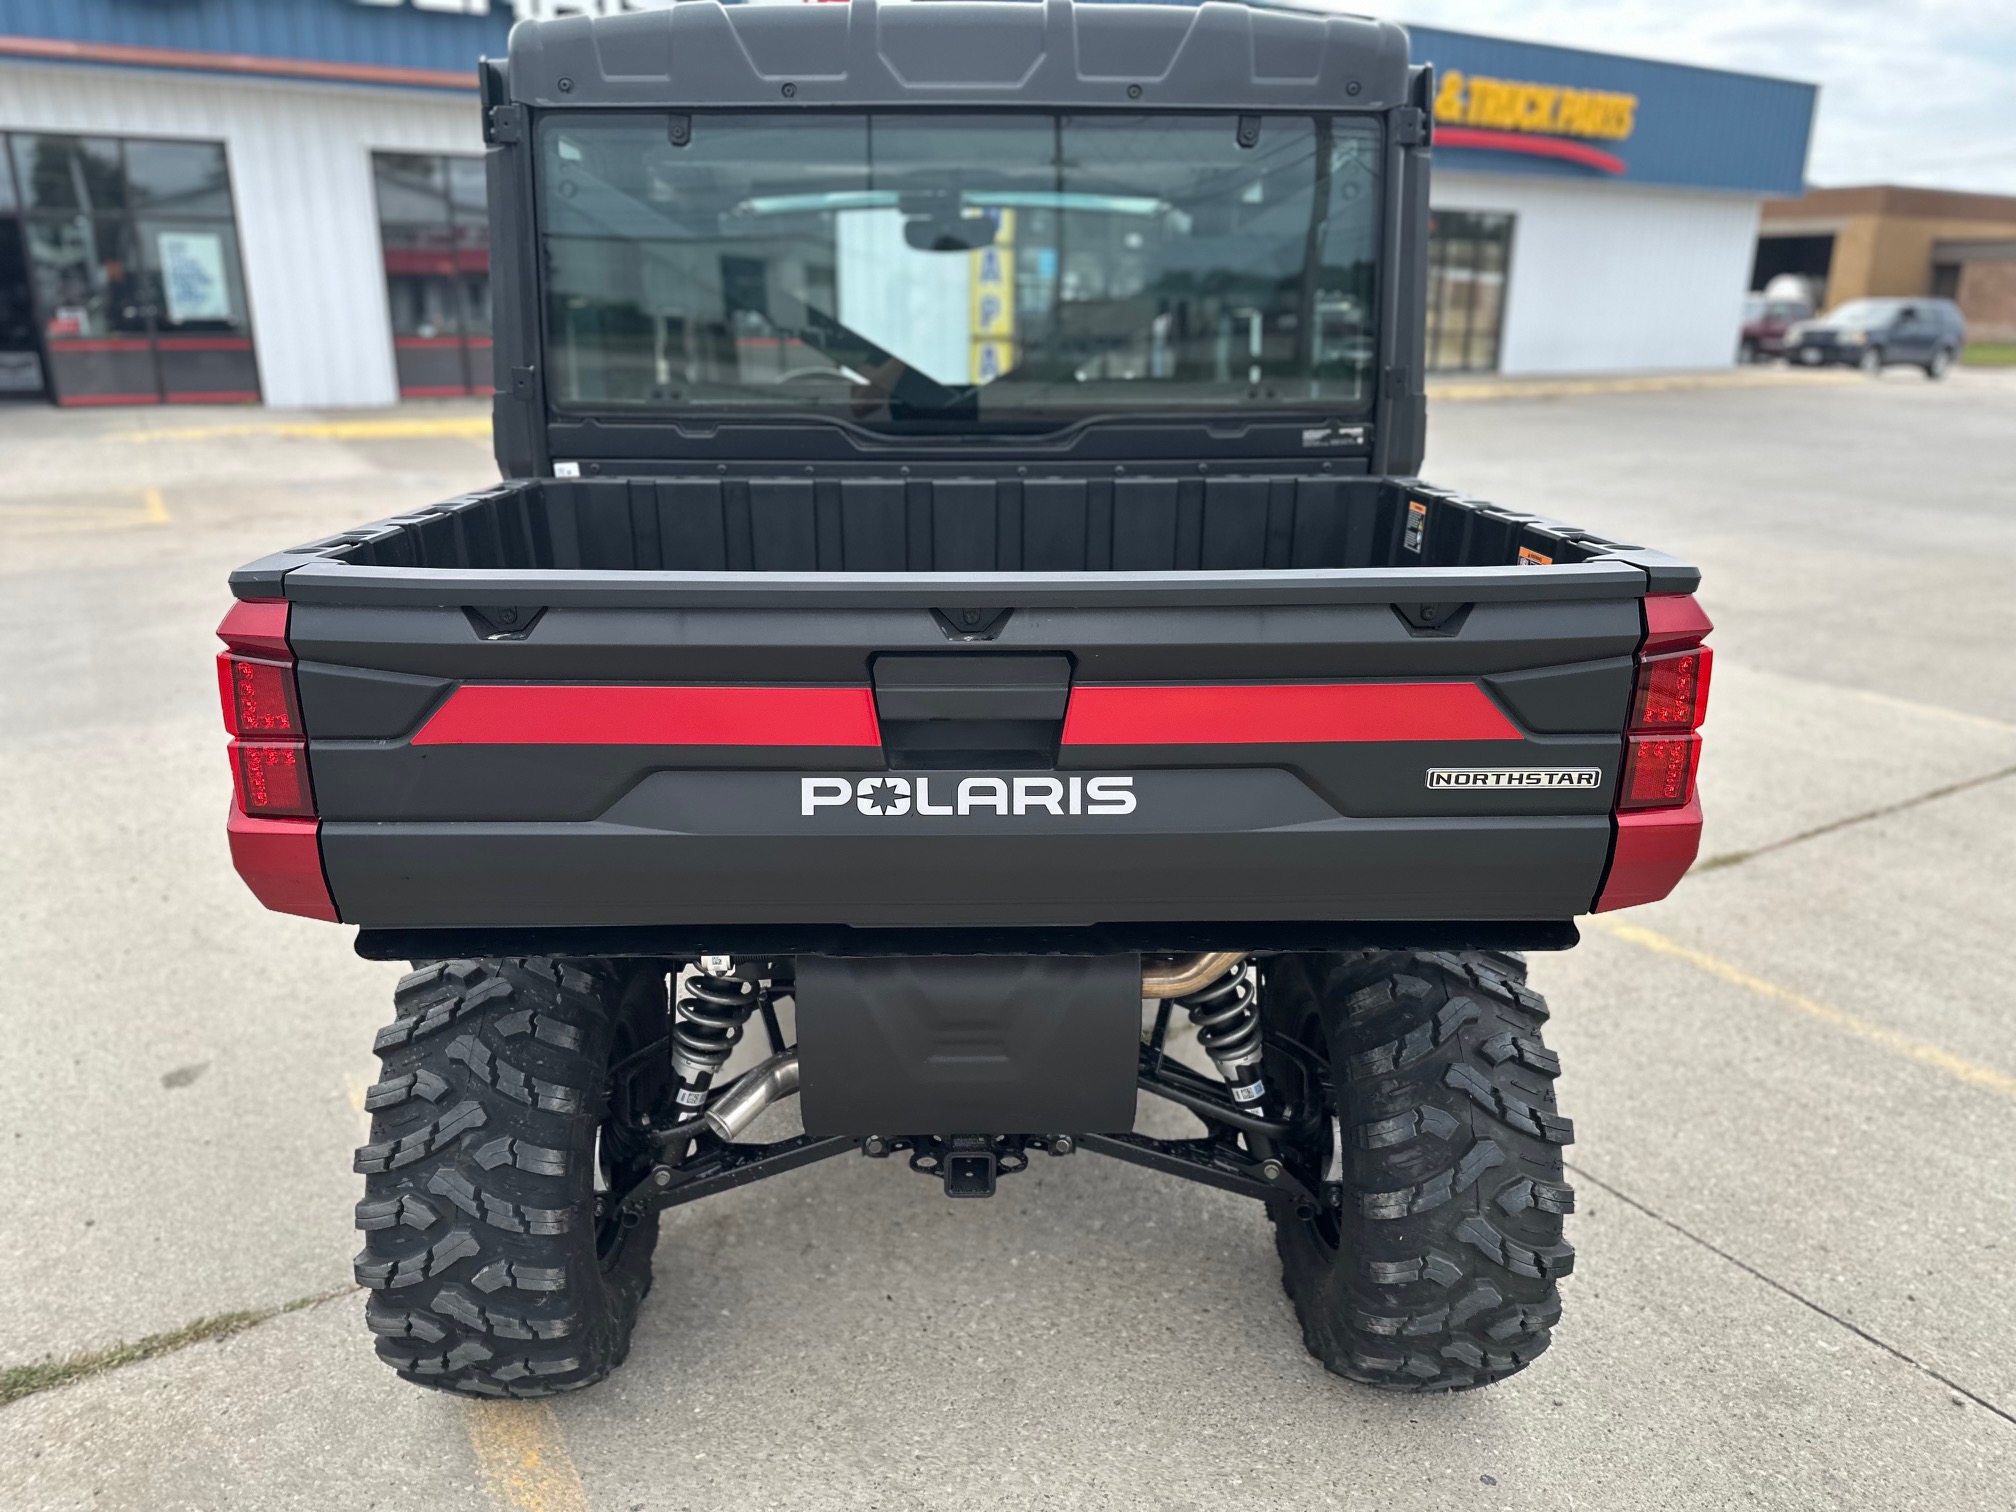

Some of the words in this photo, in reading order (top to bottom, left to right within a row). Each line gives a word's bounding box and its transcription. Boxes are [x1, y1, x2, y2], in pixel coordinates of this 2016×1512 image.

[1435, 69, 1464, 122] &
[1467, 75, 1557, 132] TRUCK
[1556, 86, 1637, 140] PARTS
[801, 777, 1137, 816] POLARIS
[1435, 773, 1594, 786] NORTHSTAR
